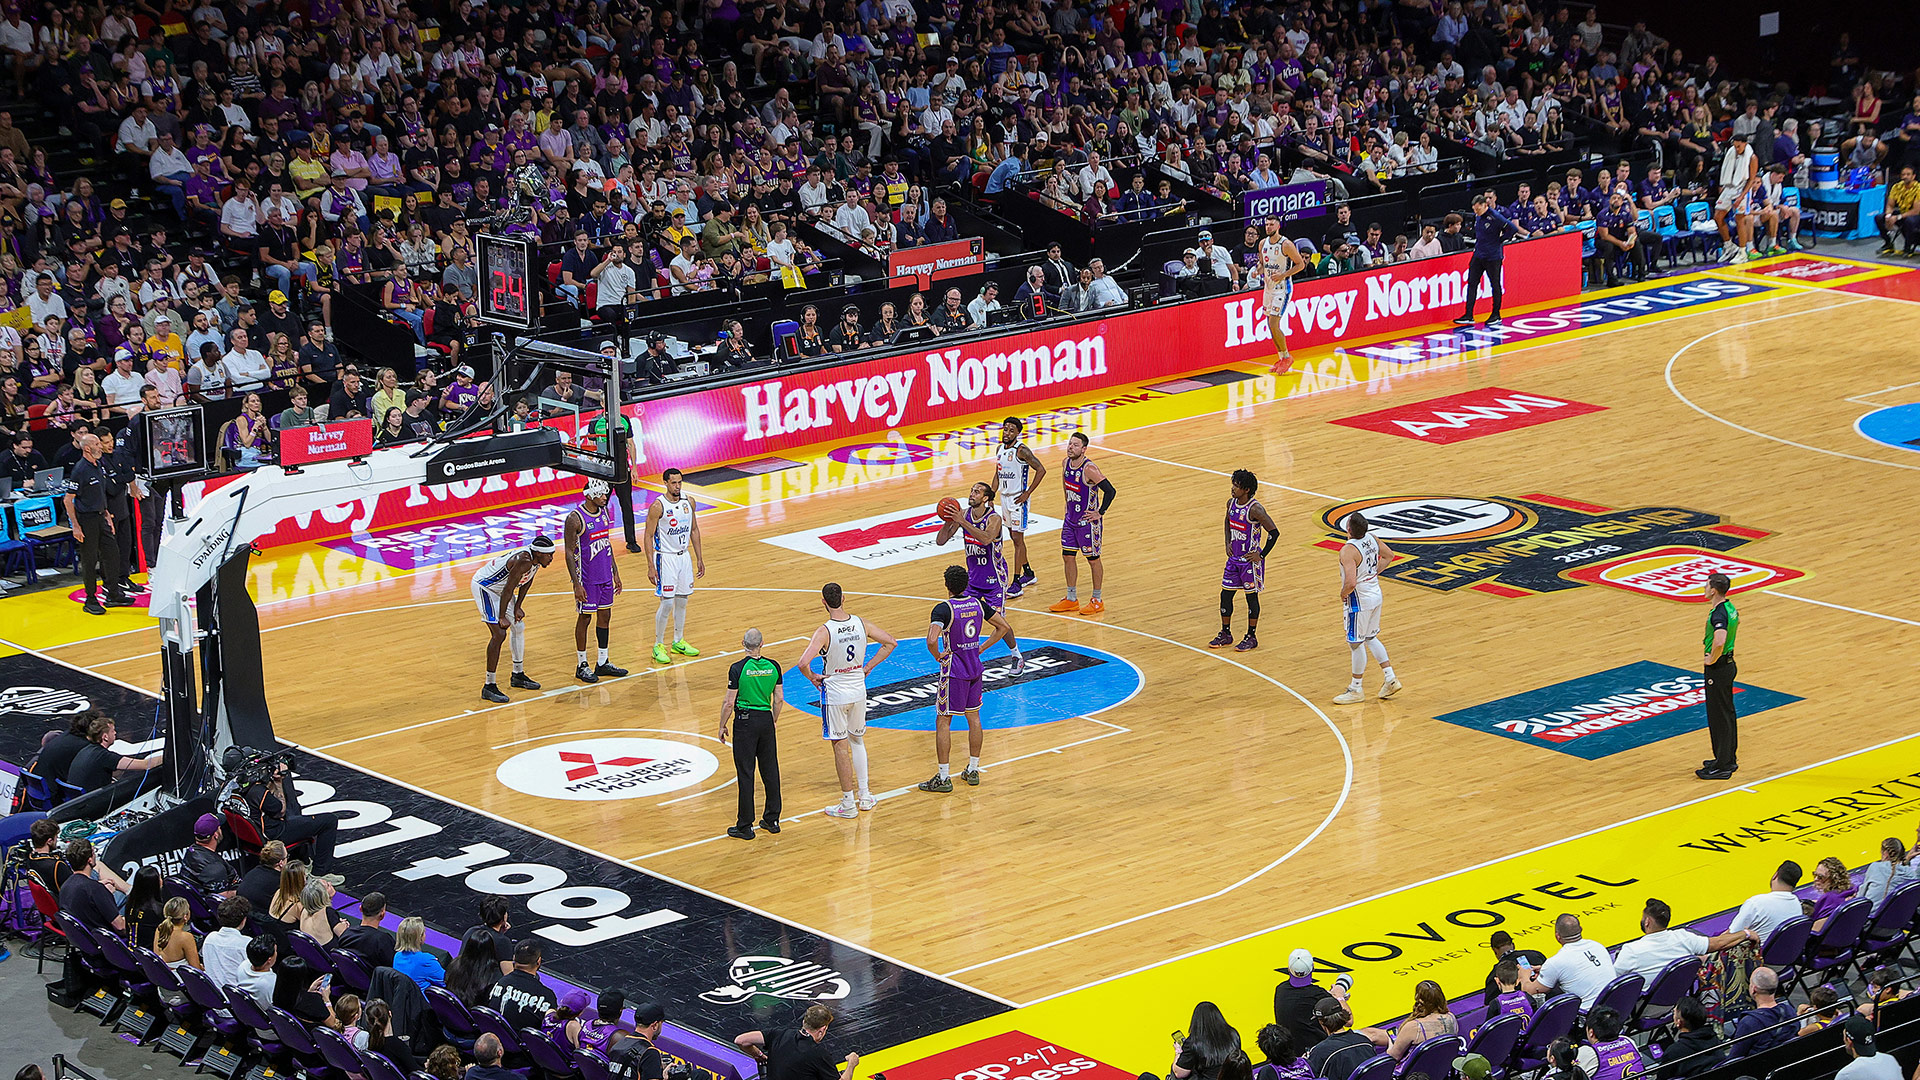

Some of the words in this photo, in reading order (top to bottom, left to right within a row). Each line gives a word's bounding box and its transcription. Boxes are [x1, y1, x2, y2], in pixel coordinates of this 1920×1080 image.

[896, 262, 934, 277] Harvey
[936, 255, 977, 271] Norman
[493, 270, 523, 312] 24
[1033, 295, 1043, 316] 3
[1476, 281, 1750, 339] HOSTPLUS
[1224, 290, 1359, 348] Harvey
[466, 336, 475, 345] 20
[284, 378, 294, 387] 10
[743, 369, 918, 441] Harvey
[926, 335, 1108, 407] Norman
[1391, 394, 1569, 437] AAMI
[309, 429, 345, 443] Harvey
[307, 442, 348, 455] Norman
[456, 463, 474, 471] Qudos
[474, 460, 488, 468] Bank
[488, 457, 506, 466] Arena
[1075, 503, 1081, 512] 8
[1367, 504, 1493, 534] NBL
[357, 504, 569, 549] RECLAIM
[193, 528, 231, 570] SPALDING
[590, 538, 610, 561] KING
[965, 544, 987, 556] KINGS
[1240, 543, 1246, 552] 1
[1394, 509, 1694, 587] CHAMPIONSHIP
[1552, 543, 1624, 564] 2026
[977, 558, 987, 566] 10
[1623, 559, 1720, 585] HUNGRY
[964, 619, 976, 638] 6
[846, 644, 856, 662] 8
[1492, 675, 1705, 735] BUNNINGS
[1546, 688, 1706, 738] warehous
[565, 758, 692, 793] MITSUBISHI
[597, 767, 692, 794] MOTORS
[1274, 874, 1640, 983] NOVOTEL
[1393, 947, 1472, 977] SYDNEY
[1008, 1045, 1058, 1066] 24/7
